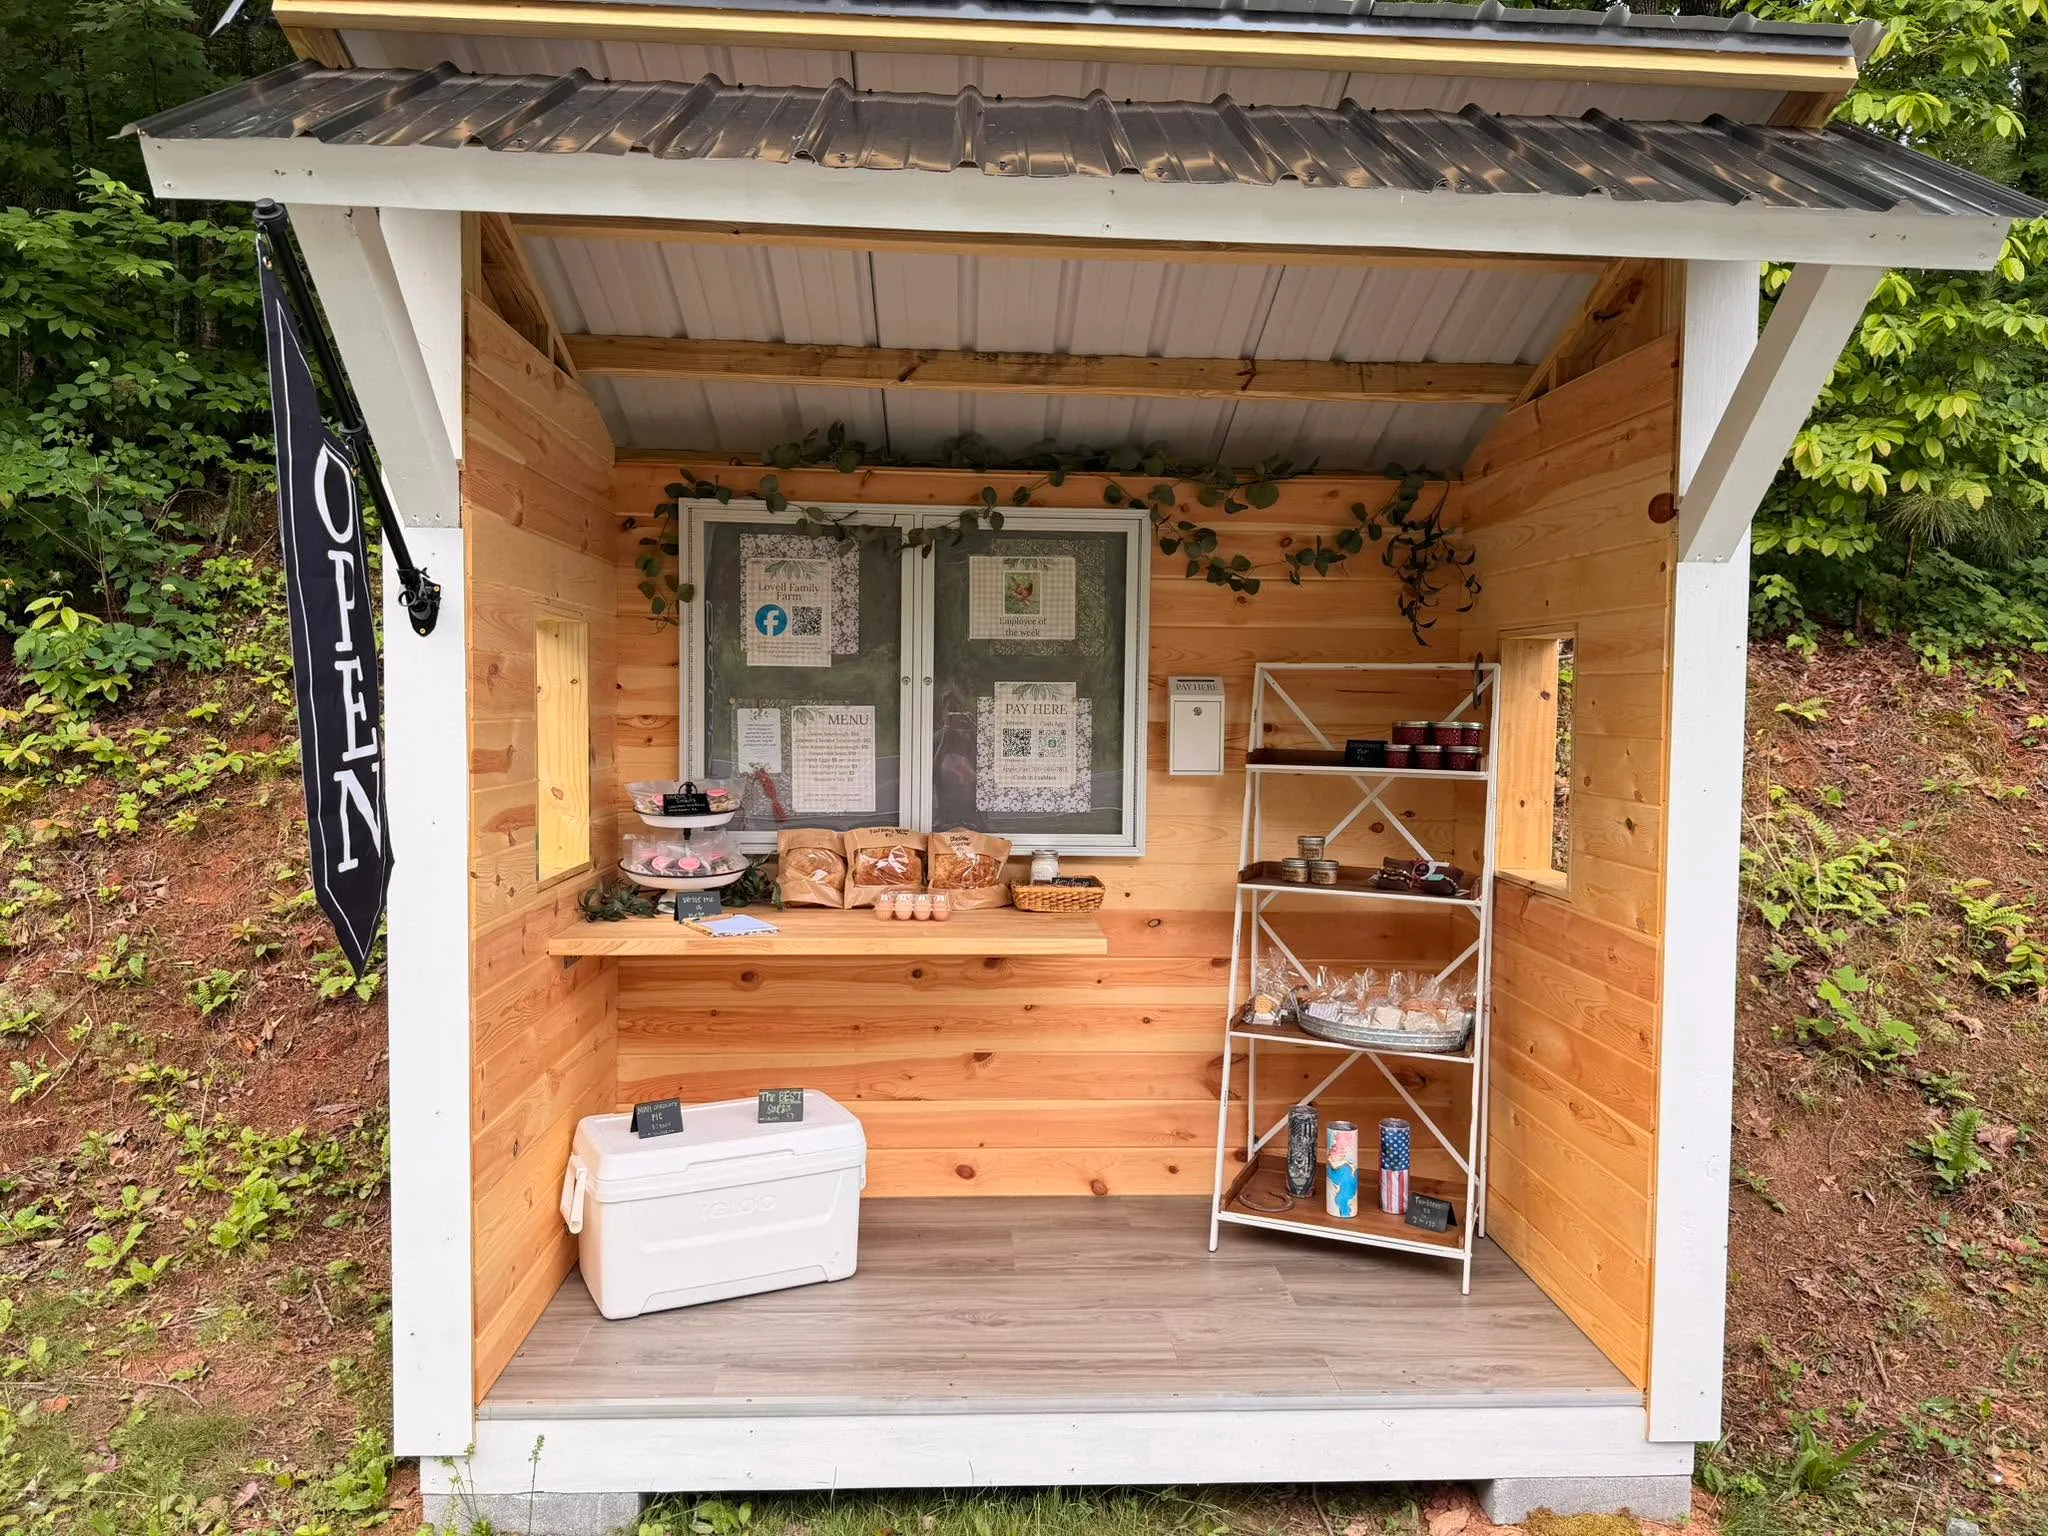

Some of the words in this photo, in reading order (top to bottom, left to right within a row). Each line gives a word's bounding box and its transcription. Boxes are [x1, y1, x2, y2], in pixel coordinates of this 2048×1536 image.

[789, 583, 820, 595] Family
[776, 591, 802, 600] Farm
[999, 617, 1036, 627] Employee
[1038, 617, 1048, 625] of
[1005, 629, 1018, 637] the
[1020, 629, 1041, 637] week
[314, 439, 383, 874] OPEN
[1194, 683, 1218, 691] HERE
[1005, 703, 1029, 714] PAY
[1033, 703, 1068, 715] HERE
[828, 714, 869, 725] MENU
[778, 1090, 802, 1102] BEST
[699, 1194, 777, 1220] IGLOO
